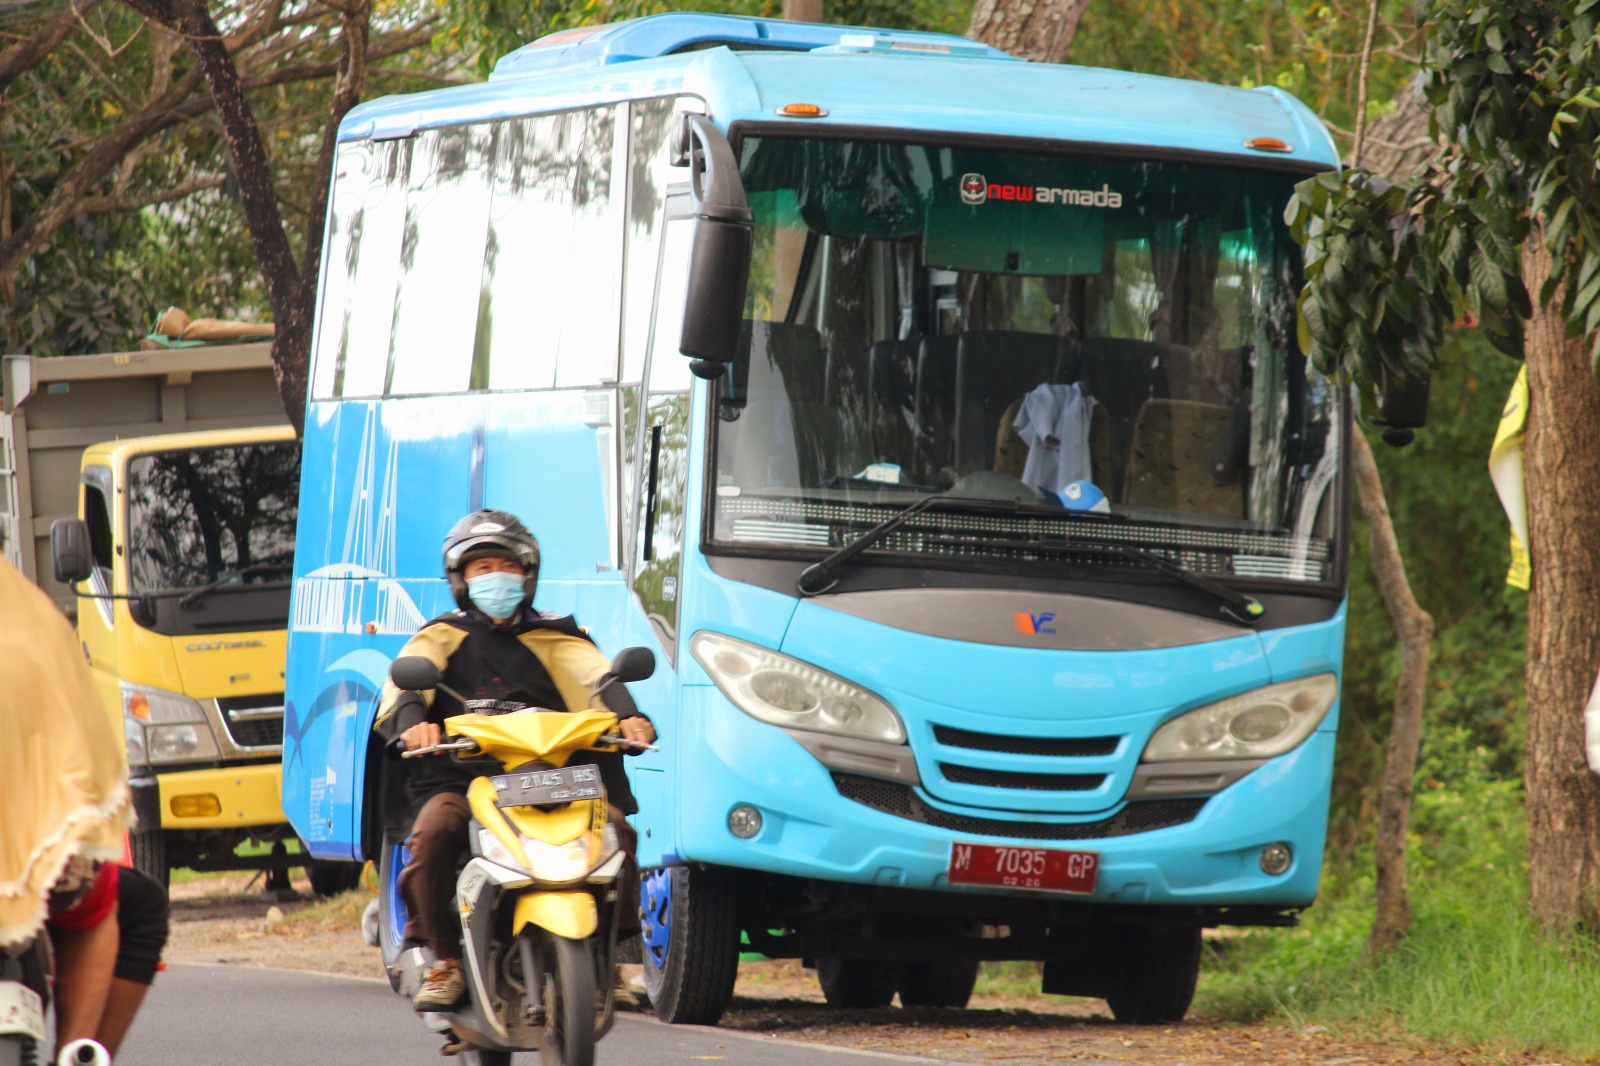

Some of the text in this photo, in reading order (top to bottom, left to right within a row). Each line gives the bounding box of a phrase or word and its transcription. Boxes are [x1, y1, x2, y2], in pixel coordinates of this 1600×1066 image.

[987, 183, 1123, 209] new armada
[520, 773, 563, 789] 2145
[954, 845, 1095, 879] M 7035 GP
